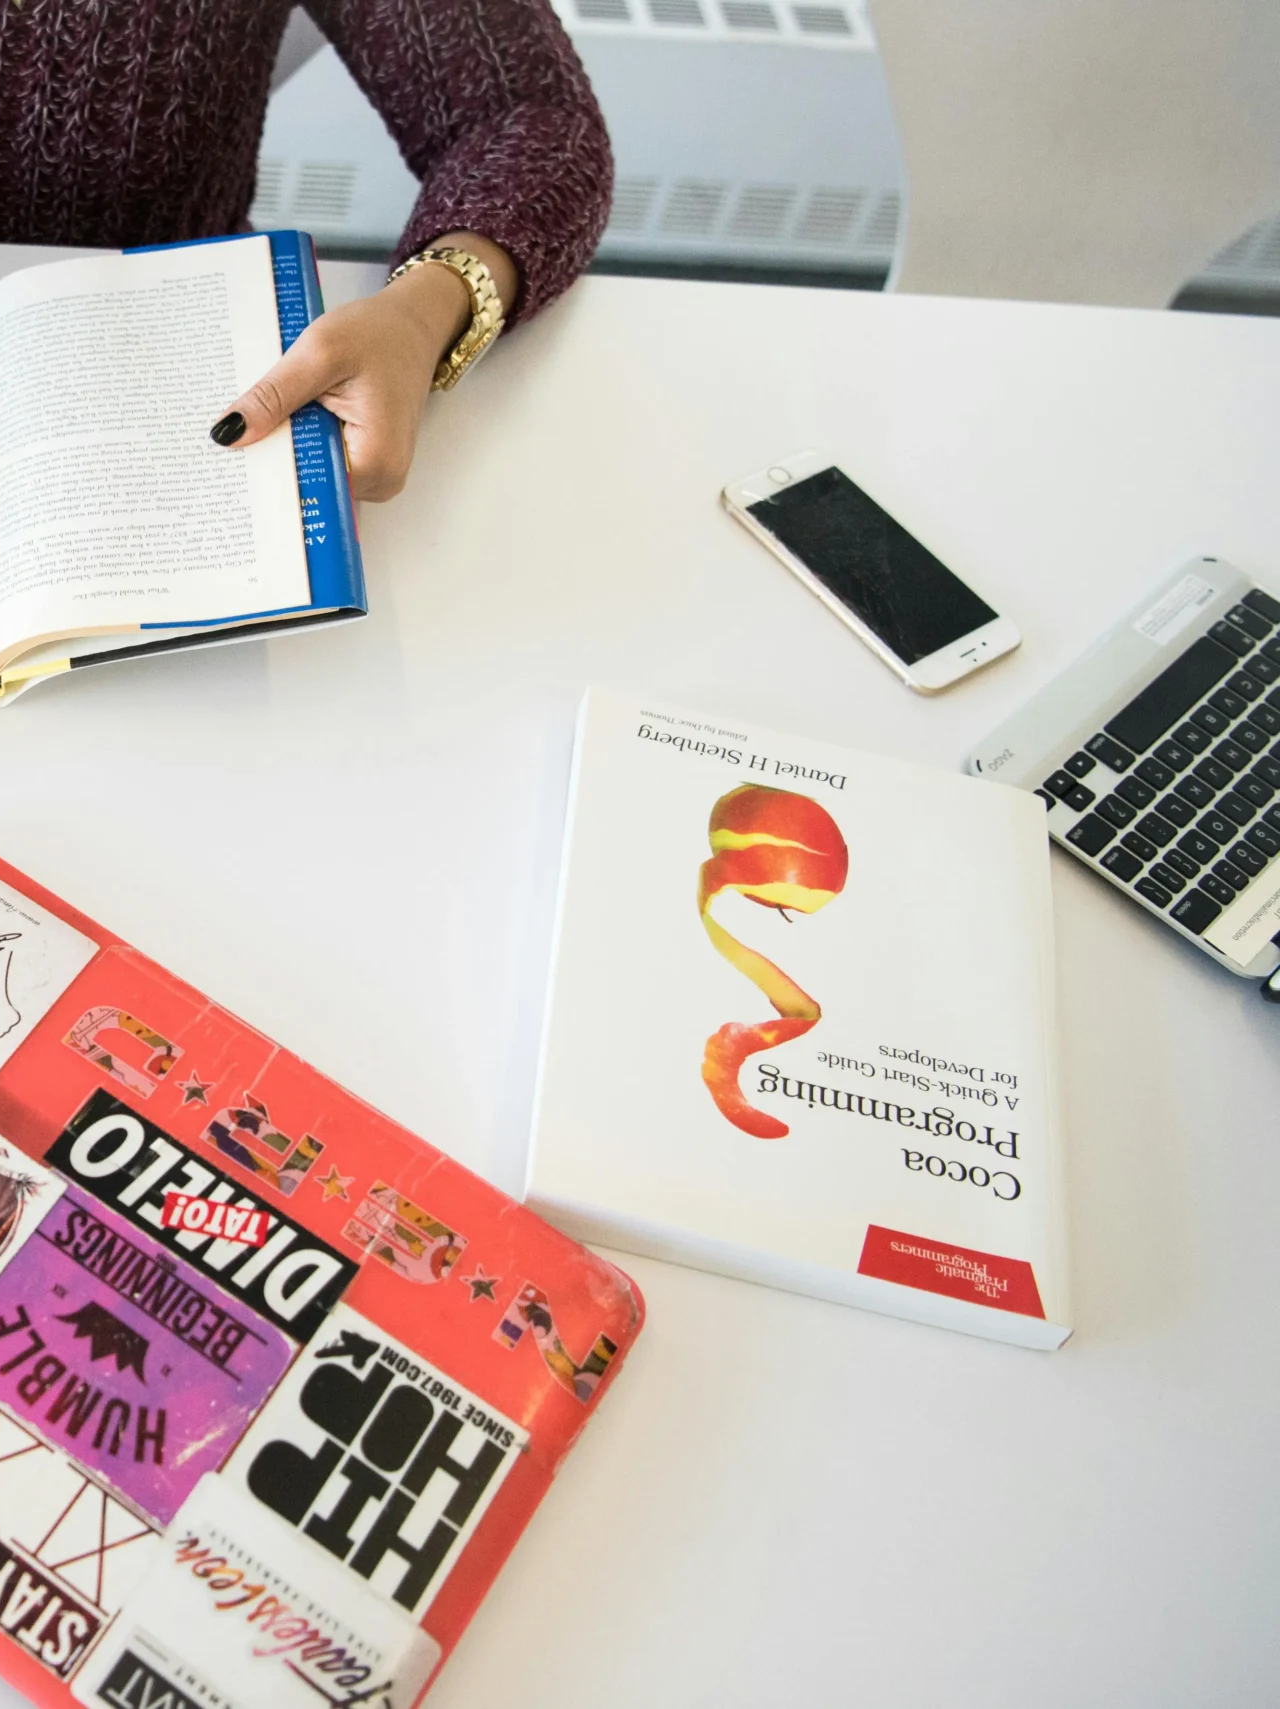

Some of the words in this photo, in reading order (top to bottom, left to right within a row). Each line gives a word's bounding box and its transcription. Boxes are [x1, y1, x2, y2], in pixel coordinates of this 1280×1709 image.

[299, 509, 320, 519] urg
[316, 535, 326, 544] A
[90, 591, 118, 599] Google
[640, 710, 675, 724] Thomas
[678, 720, 702, 731] Dave
[704, 725, 716, 734] by
[637, 725, 742, 764] Steinberg
[718, 729, 748, 742] Edited
[749, 755, 767, 771] H
[775, 761, 847, 790] Daniel
[1176, 901, 1191, 916] delete
[817, 1052, 876, 1077] Guide
[879, 1045, 984, 1082] Developers
[884, 1068, 998, 1106] Quick-Start
[991, 1072, 1017, 1089] for
[757, 1064, 1020, 1159] Programming
[1004, 1096, 1019, 1111] A
[901, 1148, 1021, 1201] Cocoa
[70, 1113, 343, 1325] DIMELO
[165, 1193, 264, 1243] TATO!
[887, 1238, 989, 1279] Programmers
[50, 1203, 249, 1367] BEGINNINGS
[932, 1260, 1012, 1294] Pragmatic
[973, 1279, 1003, 1298] The
[380, 1346, 461, 1410] 1987.COM
[462, 1404, 515, 1448] SINCE
[286, 1359, 509, 1532] HOP
[232, 1407, 468, 1615] HIP
